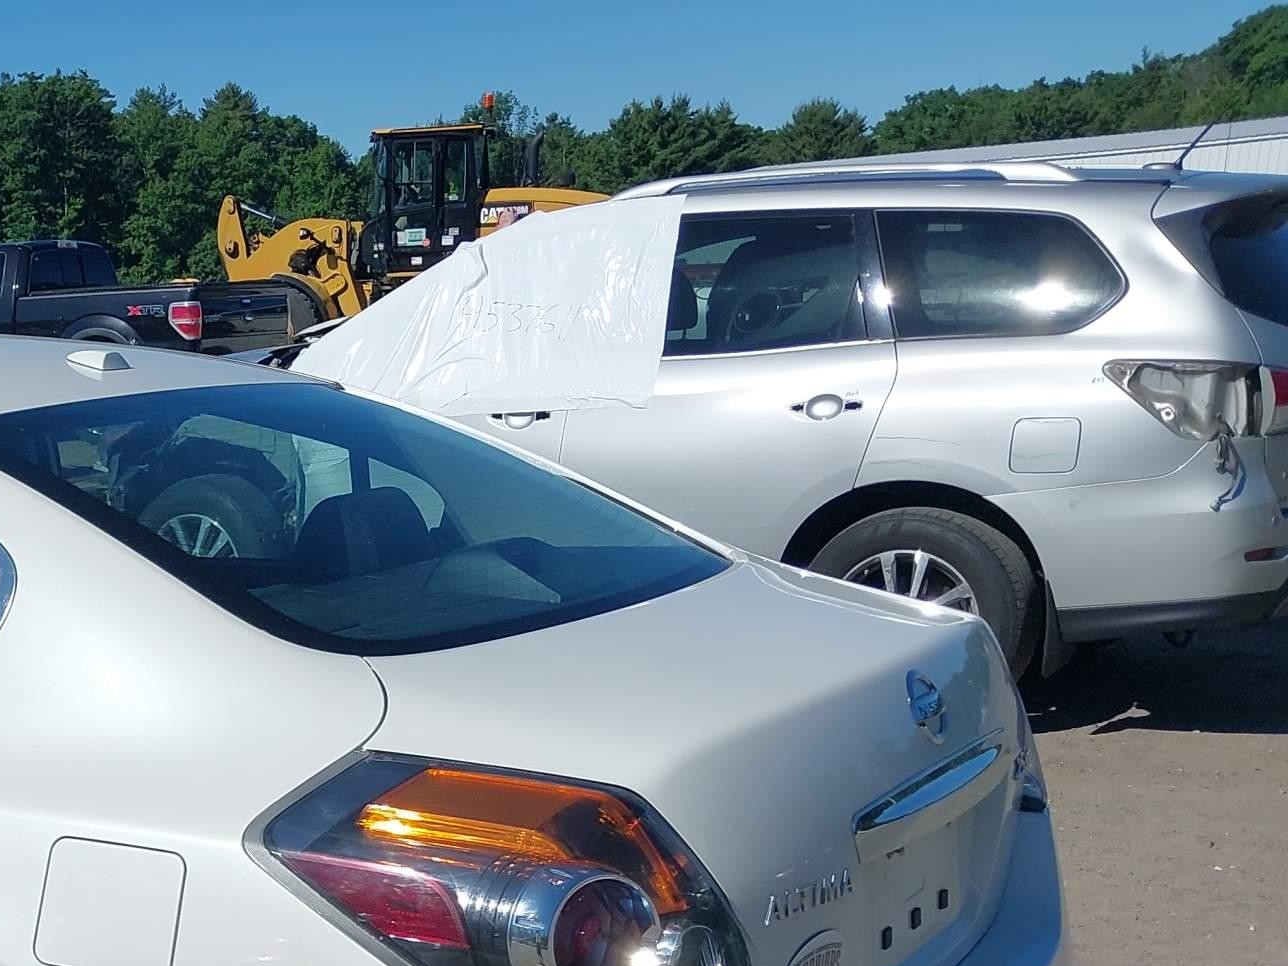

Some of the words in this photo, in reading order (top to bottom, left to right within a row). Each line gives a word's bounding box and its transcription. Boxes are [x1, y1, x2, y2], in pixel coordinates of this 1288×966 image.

[480, 207, 504, 224] CAT
[126, 304, 166, 317] XTR
[764, 867, 854, 927] ALTIMA
